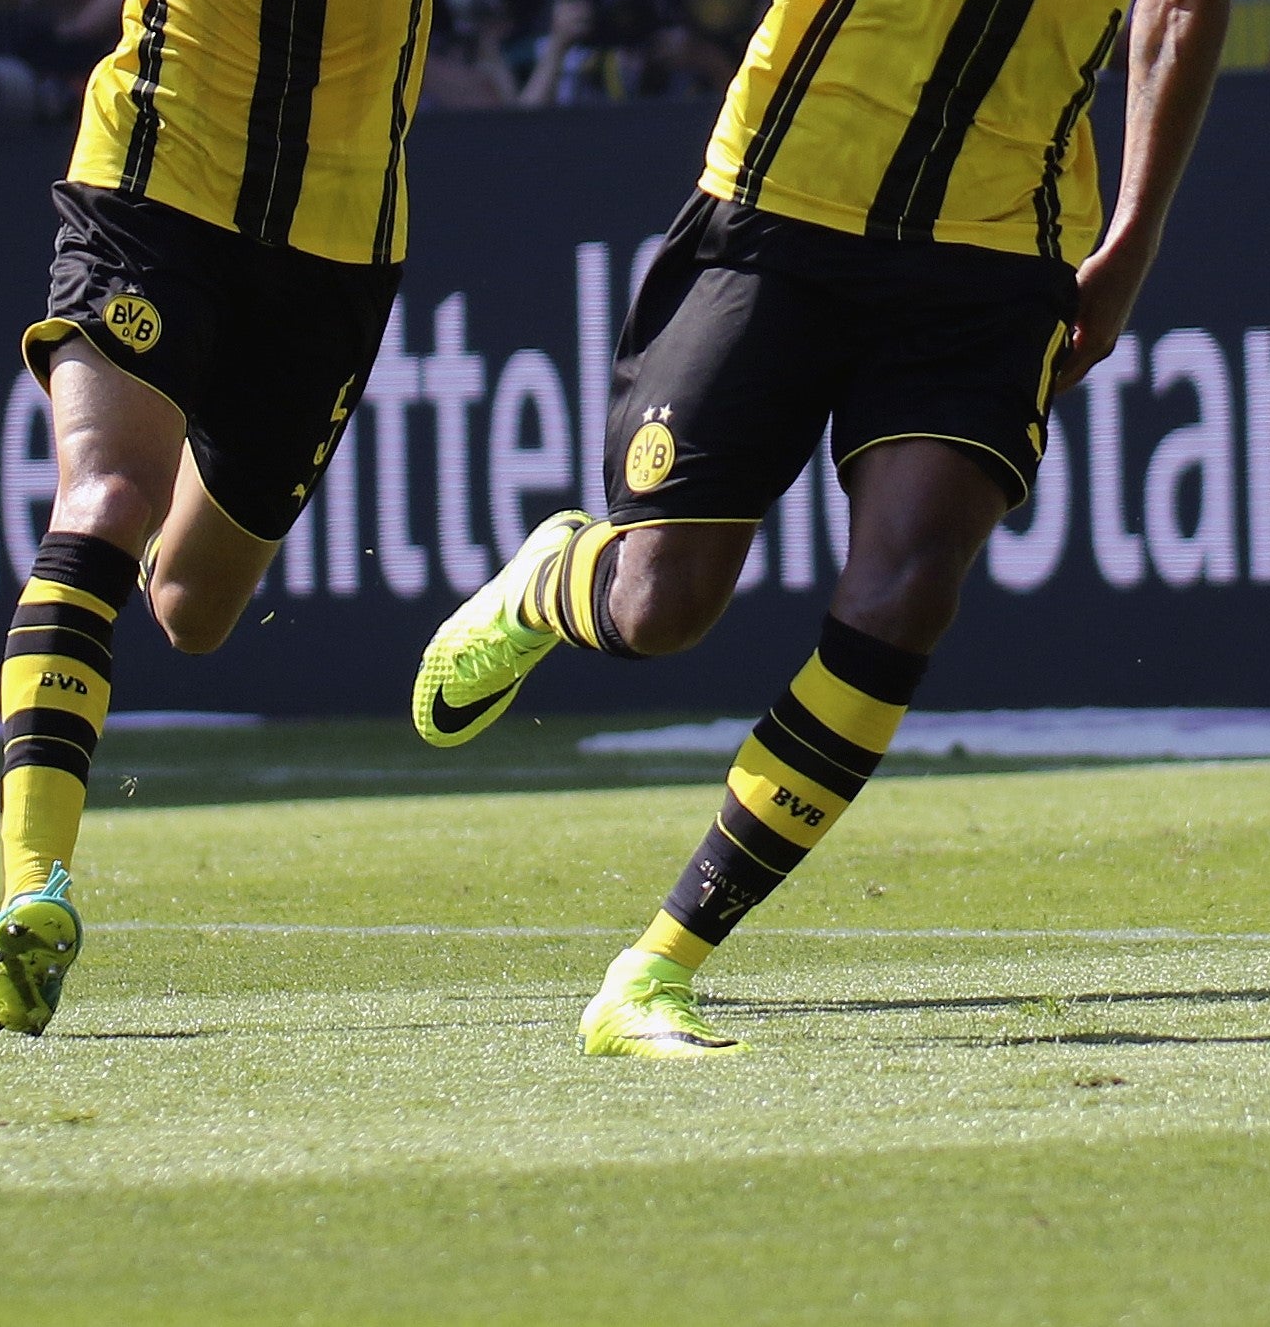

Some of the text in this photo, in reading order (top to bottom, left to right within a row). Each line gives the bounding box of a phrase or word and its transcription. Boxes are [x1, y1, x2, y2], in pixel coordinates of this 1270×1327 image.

[111, 301, 154, 342] BVB
[631, 431, 667, 470] BVB
[771, 785, 825, 827] BVB
[699, 880, 745, 921] 17
